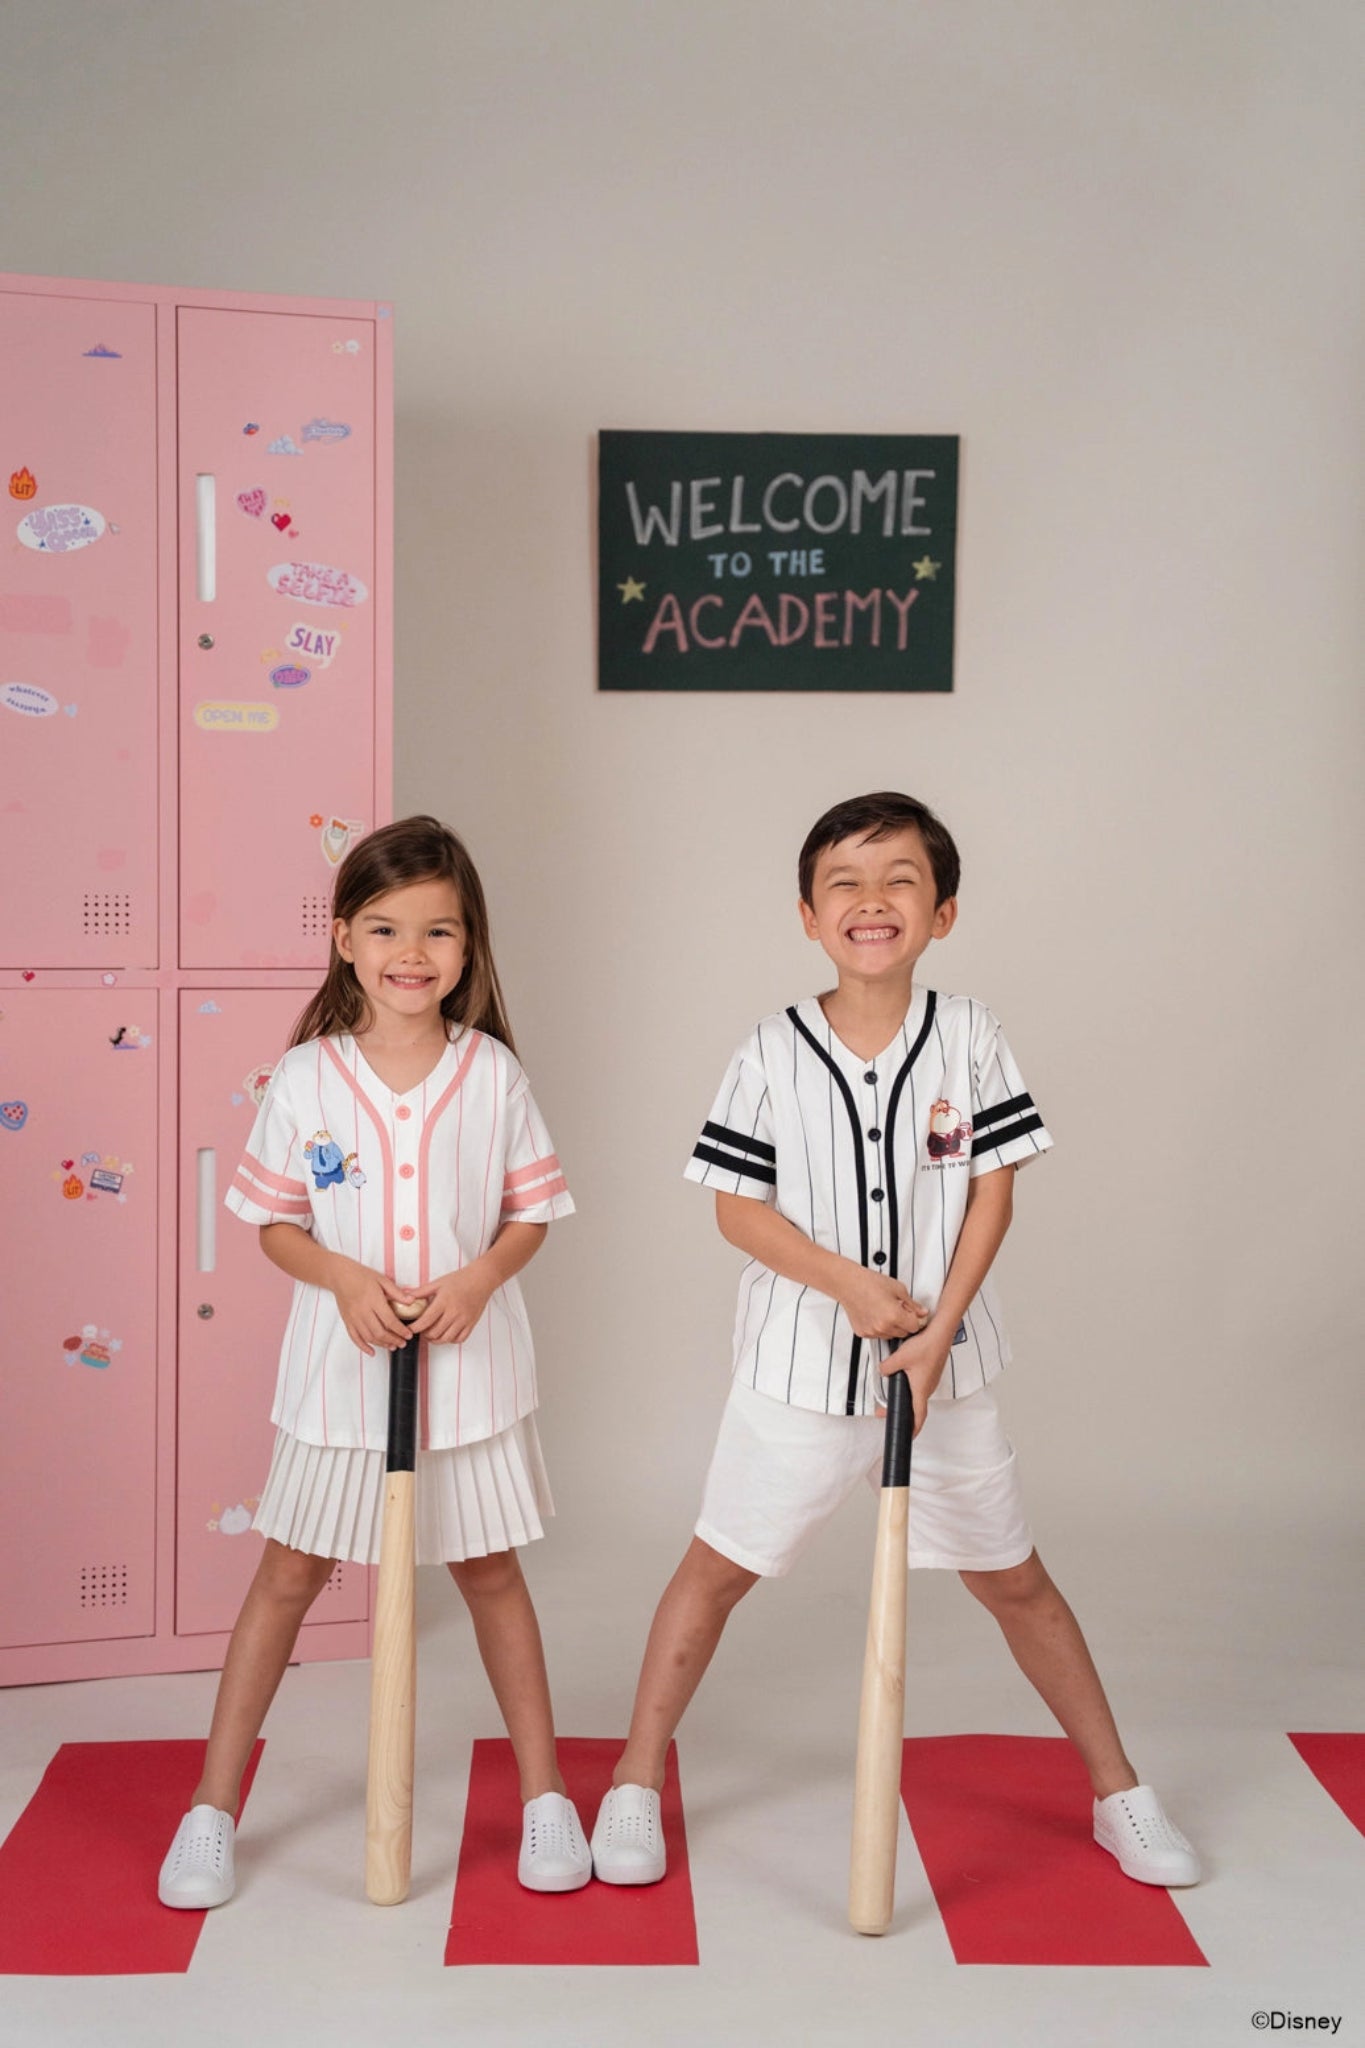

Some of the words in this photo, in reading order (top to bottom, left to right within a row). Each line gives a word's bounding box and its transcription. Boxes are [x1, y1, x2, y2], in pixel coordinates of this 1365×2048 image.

[15, 483, 31, 495] LIT
[626, 470, 936, 546] WELCOME
[708, 552, 752, 578] TO
[768, 549, 826, 576] THE
[337, 573, 348, 585] A
[642, 588, 919, 653] ACADEMY
[290, 627, 335, 656] SLAY
[203, 708, 243, 722] OPEN
[248, 711, 270, 723] ME
